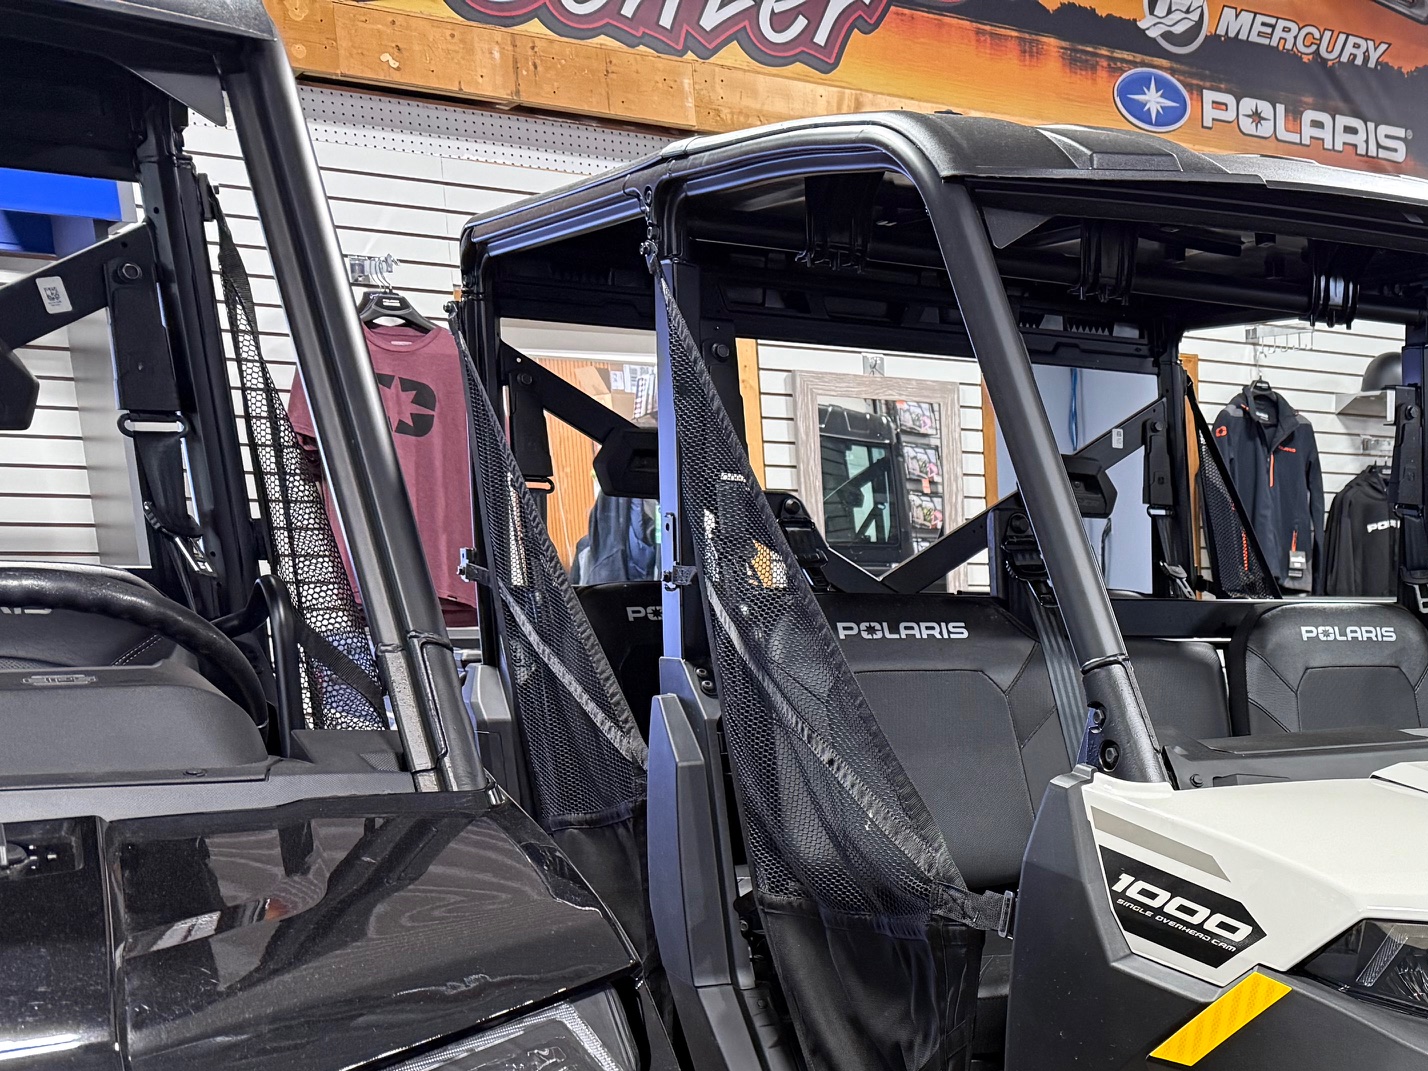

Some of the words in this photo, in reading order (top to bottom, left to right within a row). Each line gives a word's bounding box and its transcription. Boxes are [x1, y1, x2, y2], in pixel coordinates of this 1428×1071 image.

[1216, 5, 1391, 69] MERCURY
[1201, 88, 1408, 163] POLARIS
[837, 621, 970, 640] POLARIS
[1300, 626, 1397, 642] POLARIS
[1111, 872, 1253, 943] 1000
[1116, 898, 1154, 918] SINGLE
[1155, 915, 1211, 942] OVERHEAD
[1211, 938, 1237, 953] CAM
